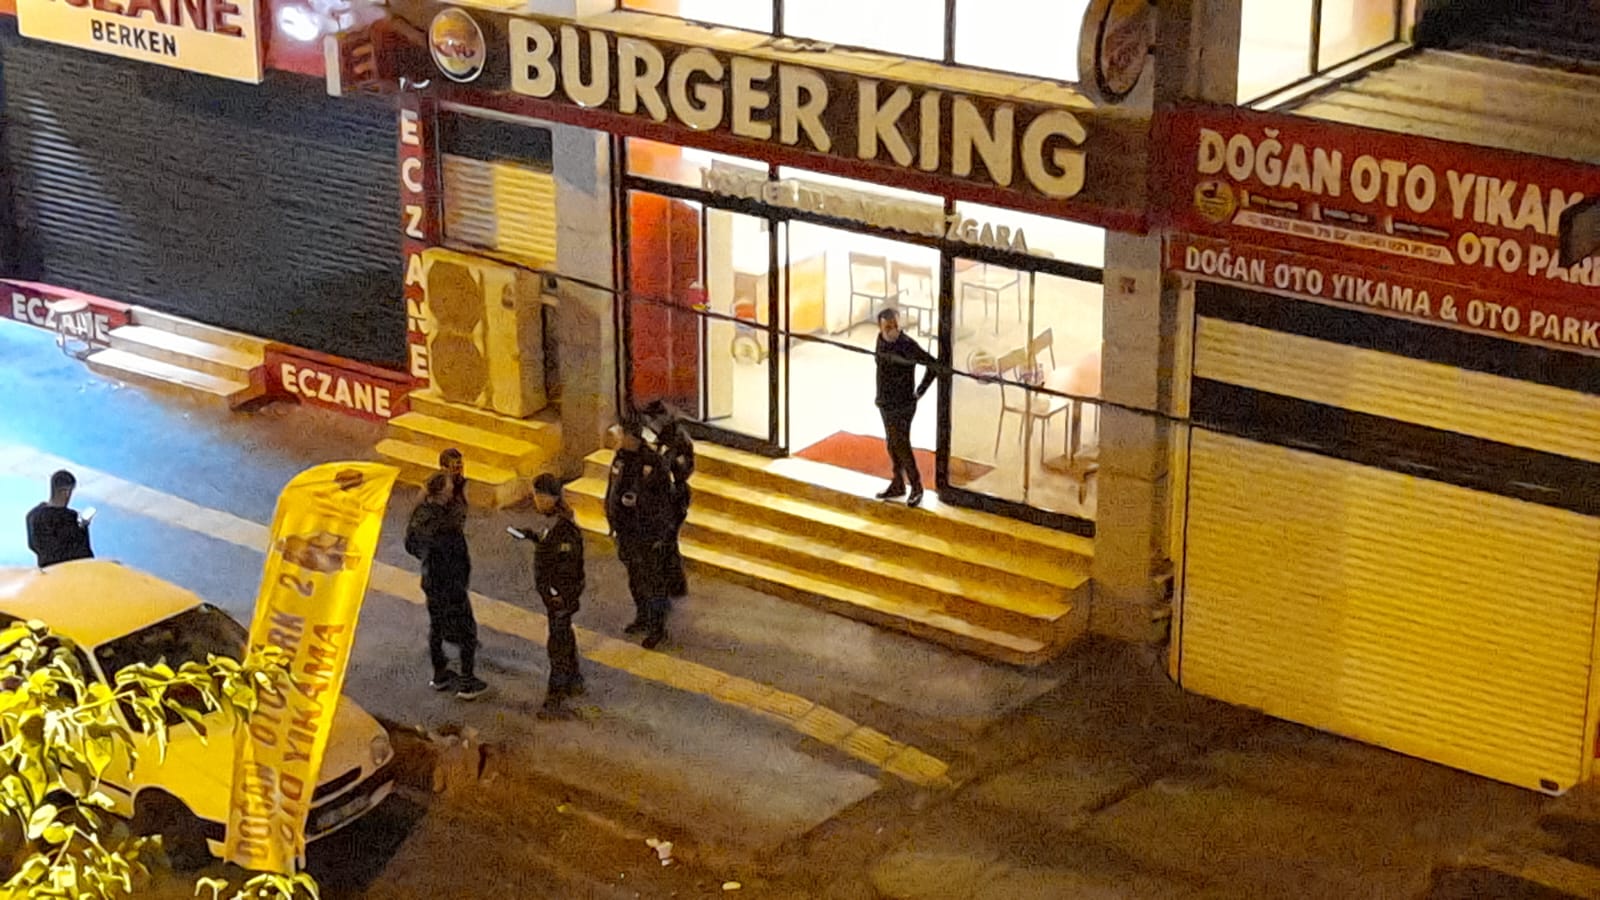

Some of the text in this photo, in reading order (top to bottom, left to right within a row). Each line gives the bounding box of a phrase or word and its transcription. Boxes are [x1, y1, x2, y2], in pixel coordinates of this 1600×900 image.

[90, 19, 177, 57] BERKEN
[508, 18, 1087, 200] BURGER KING
[1197, 127, 1342, 197] DOĞAN
[1350, 154, 1436, 213] OTO
[1446, 169, 1585, 237] YIKA
[1185, 246, 1266, 284] DOĞAN
[1274, 263, 1324, 295] OTO
[1332, 273, 1431, 316] YIKAMA
[1440, 295, 1458, 323] &
[1466, 299, 1521, 332] OTO
[1457, 232, 1522, 273] OTO
[281, 362, 392, 418] ECZANE
[283, 624, 345, 762] YIKAMA
